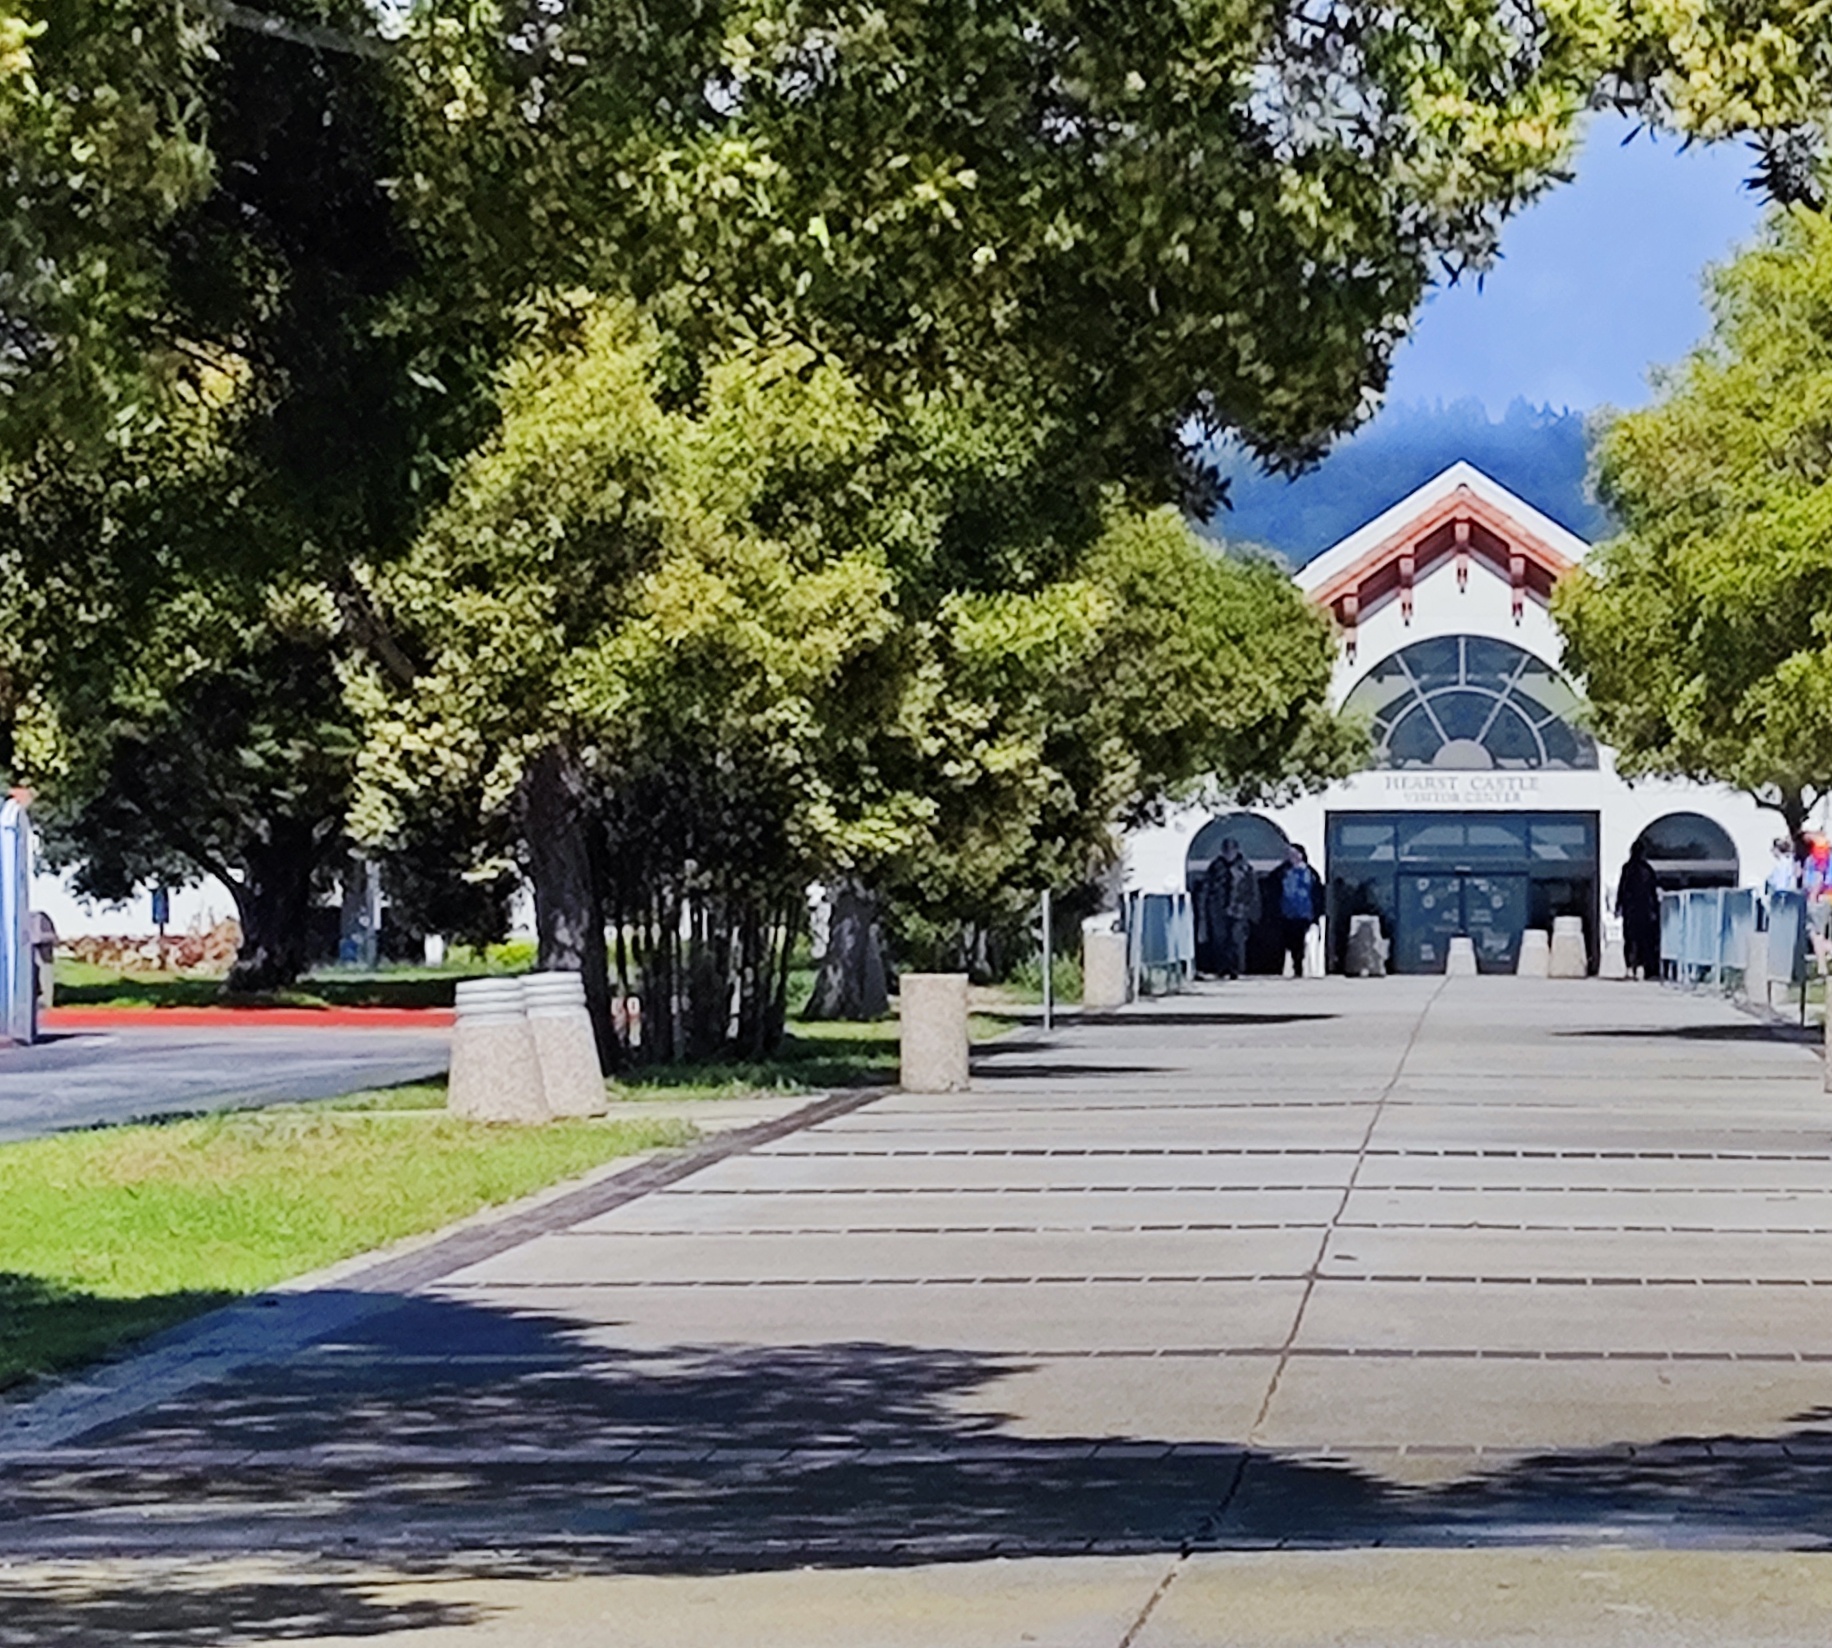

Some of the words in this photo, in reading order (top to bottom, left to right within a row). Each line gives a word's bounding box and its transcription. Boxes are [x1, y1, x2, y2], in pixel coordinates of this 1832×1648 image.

[1385, 776, 1458, 790] HEARST
[1470, 776, 1539, 791] CASTLE
[1403, 791, 1459, 803] VISITOR
[1464, 791, 1521, 803] CENTER
